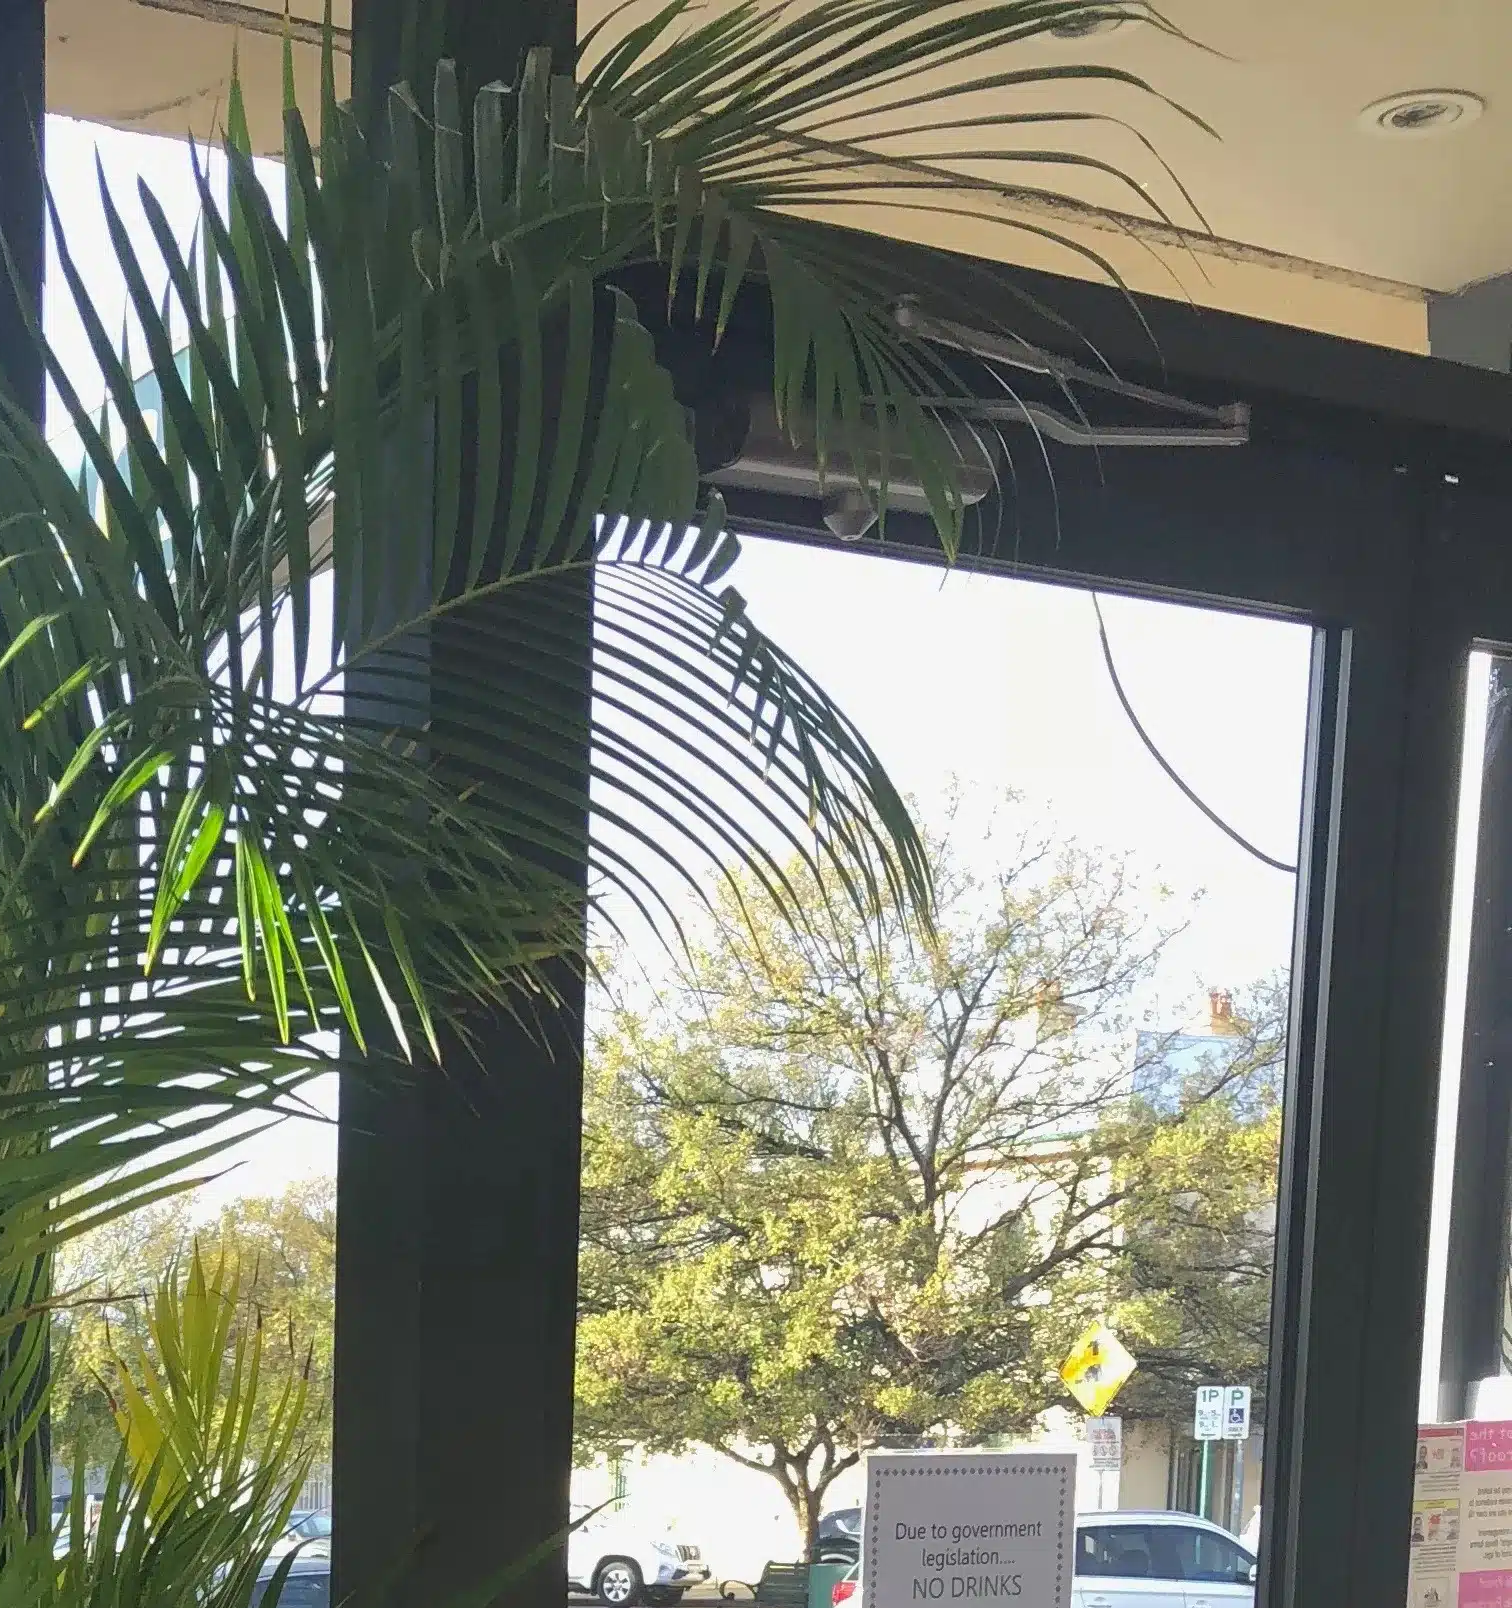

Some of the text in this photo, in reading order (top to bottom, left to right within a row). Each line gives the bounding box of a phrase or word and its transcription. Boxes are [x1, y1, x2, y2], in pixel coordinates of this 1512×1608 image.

[895, 1520, 1042, 1543] Due to government
[912, 1574, 1022, 1599] NO DRINKS
